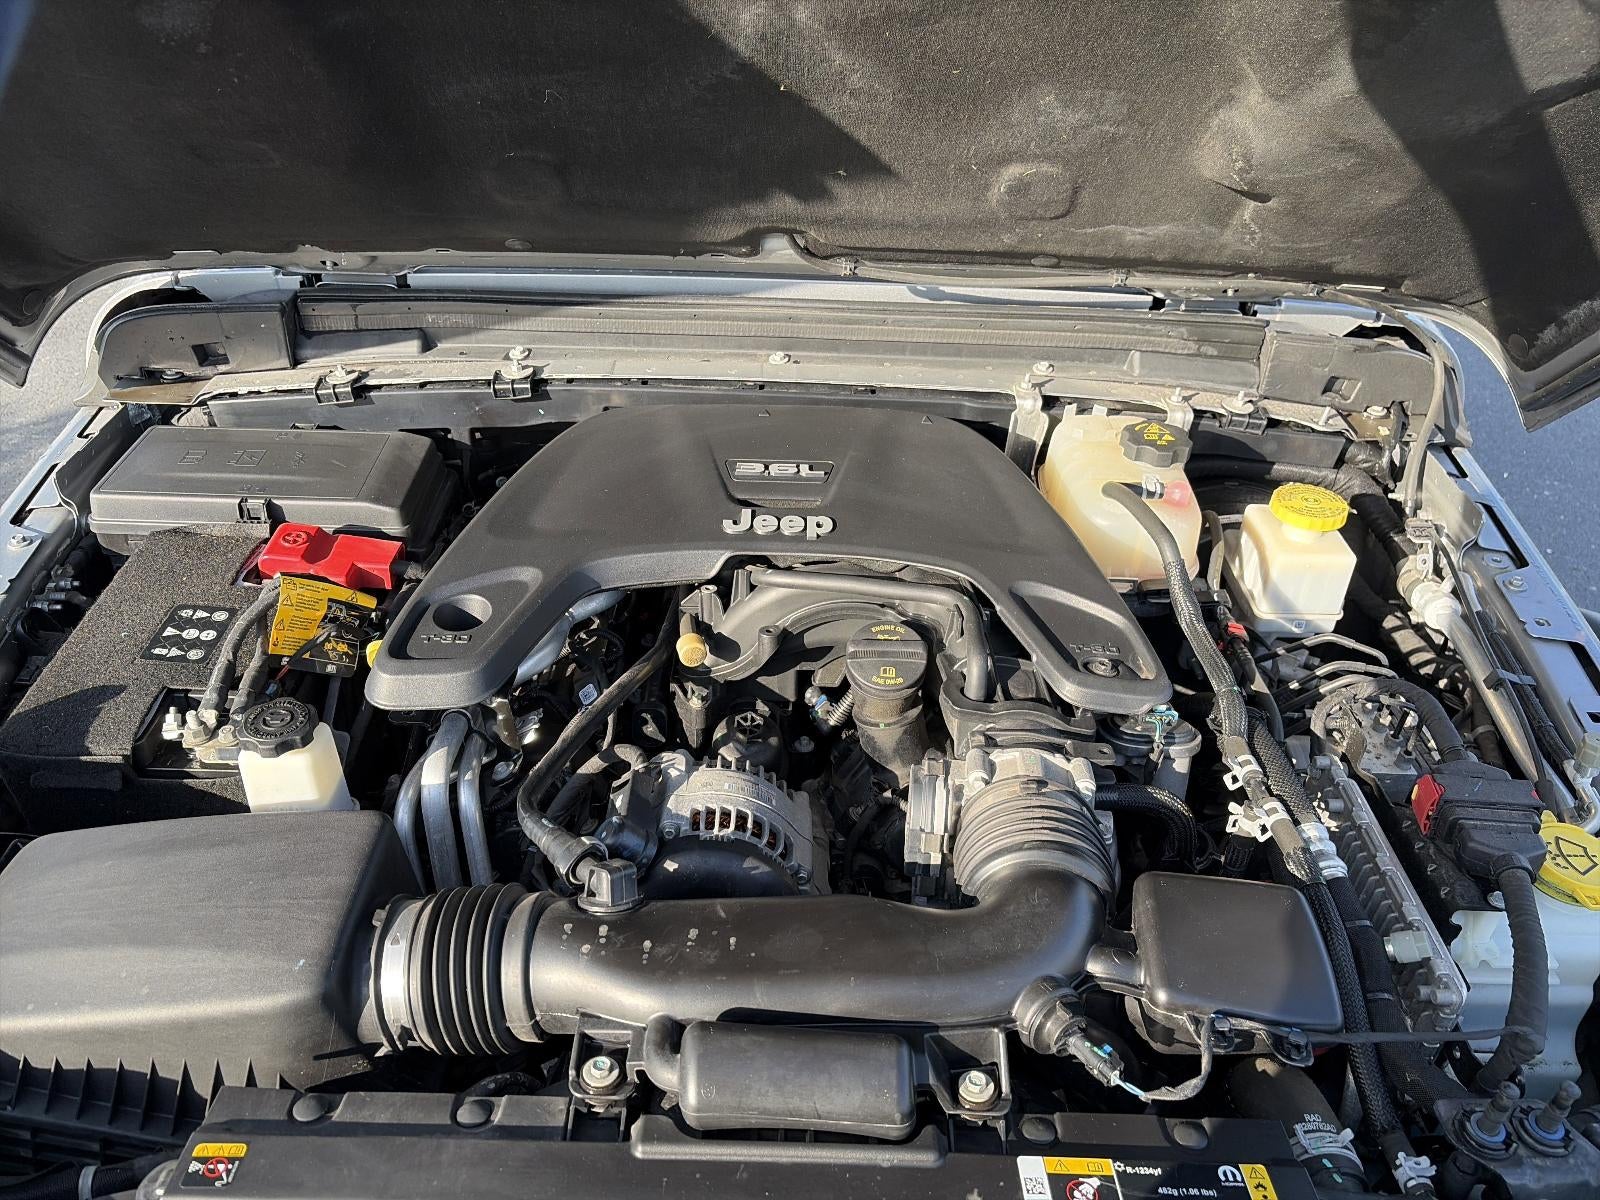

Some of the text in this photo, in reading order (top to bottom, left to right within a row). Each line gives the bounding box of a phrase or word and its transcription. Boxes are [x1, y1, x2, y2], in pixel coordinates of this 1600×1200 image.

[735, 462, 825, 477] 3.6L
[722, 508, 835, 541] Jeep
[871, 624, 906, 634] ENGINE OIL
[420, 633, 472, 644] T-30
[872, 675, 885, 685] SAE
[1303, 1113, 1322, 1122] RAD
[1200, 1188, 1218, 1198] lbs)
